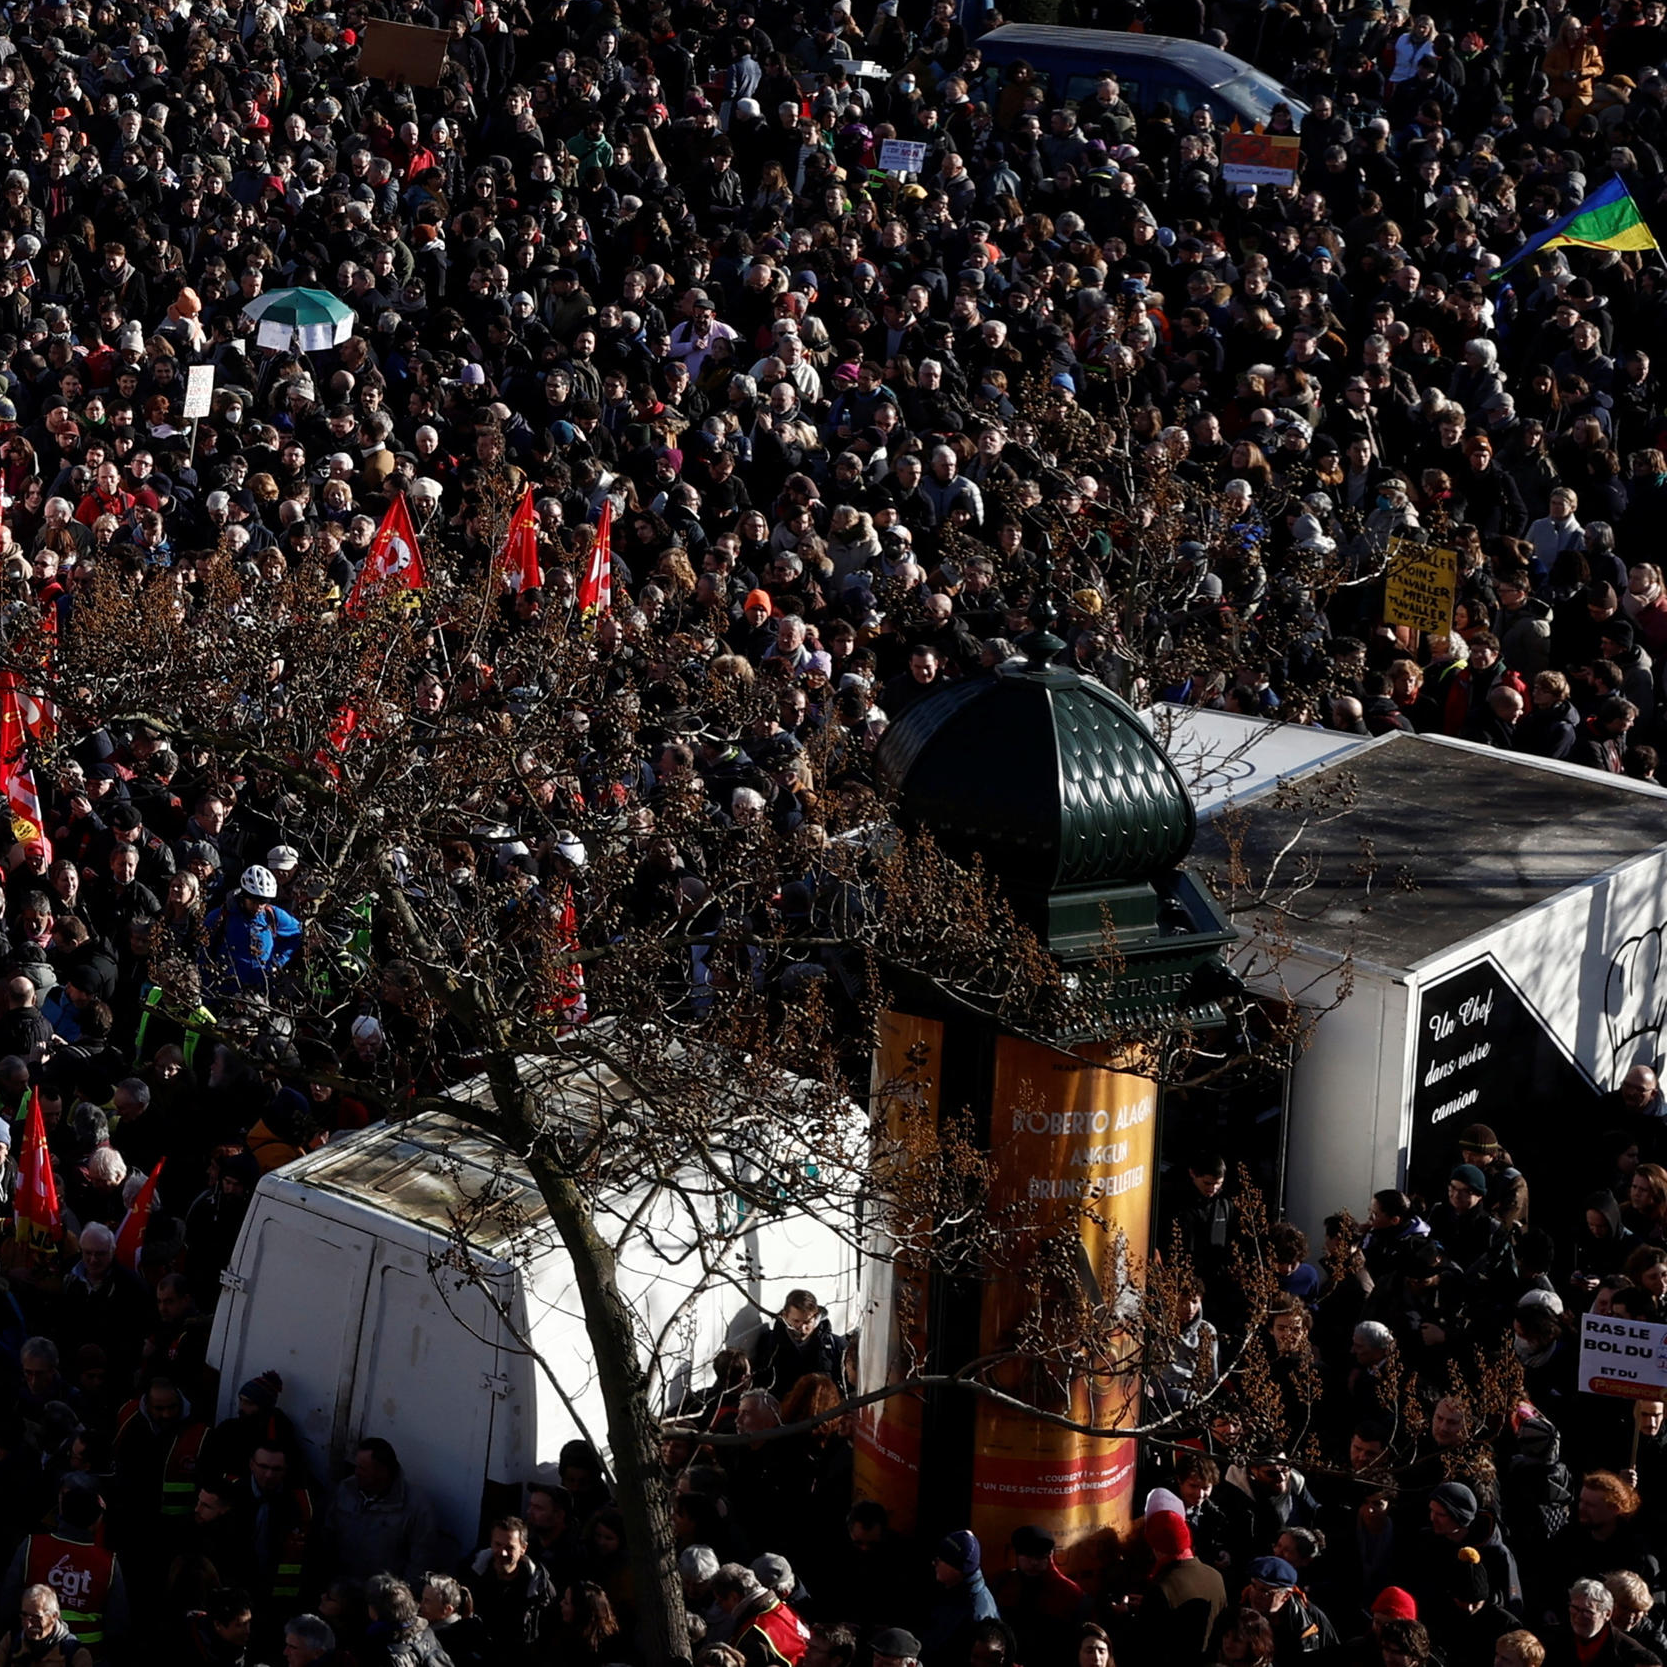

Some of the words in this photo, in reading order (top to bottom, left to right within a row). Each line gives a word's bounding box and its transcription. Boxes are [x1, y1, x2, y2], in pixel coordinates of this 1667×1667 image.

[1402, 588, 1438, 607] MIEUX
[1429, 1010, 1456, 1042] Un
[1458, 988, 1493, 1027] Chef
[1424, 1058, 1456, 1087] dans
[1457, 1041, 1491, 1069] votre
[1431, 1088, 1479, 1124] camion
[1012, 1109, 1110, 1135] ROBERTO
[1070, 1141, 1129, 1166] ANGGUN
[1102, 1165, 1145, 1197] PELLETIER
[1585, 1320, 1625, 1336] RAS
[1629, 1326, 1650, 1340] LE
[1583, 1339, 1621, 1354] BOL
[1624, 1344, 1653, 1359] DU
[1600, 1366, 1615, 1376] ET
[1616, 1369, 1637, 1379] DU
[983, 1482, 997, 1491] UN
[999, 1484, 1017, 1493] DES
[1019, 1485, 1074, 1495] SPECTACLES
[47, 1569, 92, 1597] cgt
